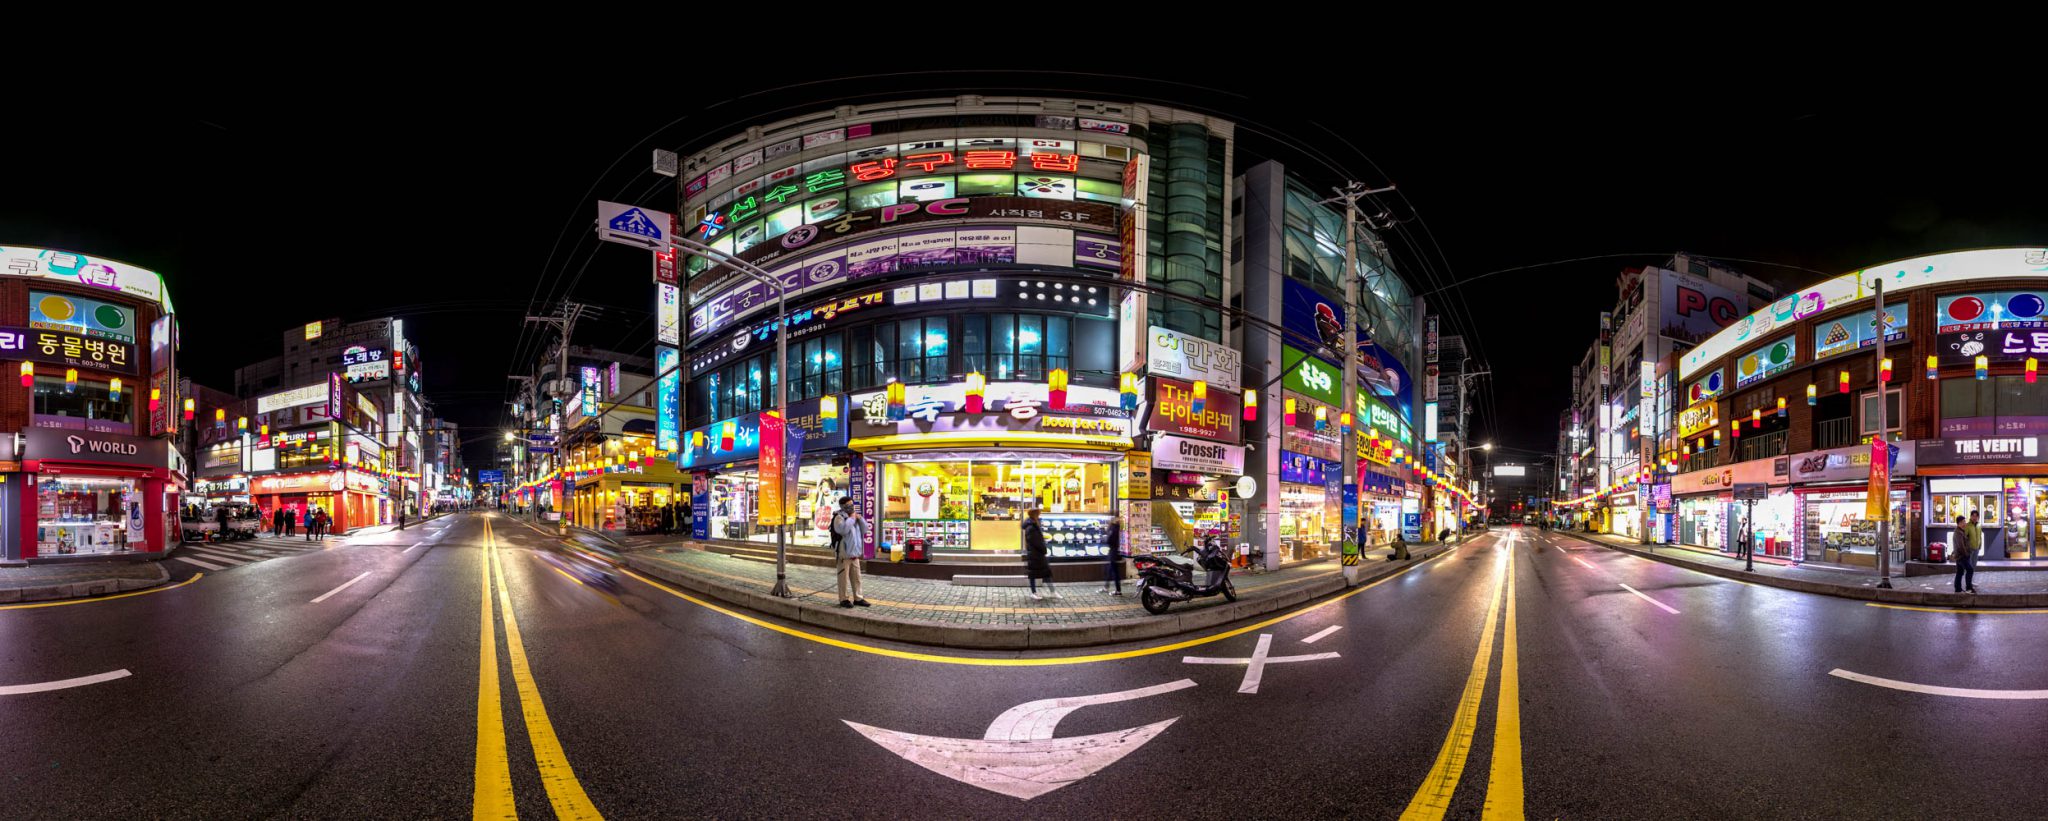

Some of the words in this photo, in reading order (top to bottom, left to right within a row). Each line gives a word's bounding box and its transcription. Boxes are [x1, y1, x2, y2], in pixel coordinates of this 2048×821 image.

[729, 169, 846, 223] 선수촌
[851, 150, 1080, 182] 당구클럽
[880, 197, 970, 224] PC
[989, 208, 1044, 220] 사직점
[1059, 210, 1092, 222] 3F
[697, 275, 728, 296] PREMIUM
[711, 298, 731, 314] PC
[813, 291, 883, 320] 생고기
[1676, 284, 1740, 329] PC
[37, 333, 126, 365] 동물병원
[343, 350, 382, 366] 노래방
[1157, 332, 1179, 351] CJ
[1182, 337, 1240, 382] 만화
[363, 369, 385, 382] PC
[1042, 415, 1073, 428] Book
[1074, 417, 1098, 430] Sae
[1160, 401, 1233, 432] 타이테라피
[1371, 404, 1398, 434] 한의원
[88, 440, 138, 456] WORLD
[1179, 440, 1226, 460] CrossFit
[1955, 439, 1980, 453] THE
[865, 463, 875, 493] Book
[987, 486, 1005, 494] Book
[865, 494, 875, 516] Sae
[863, 516, 875, 544] Tong
